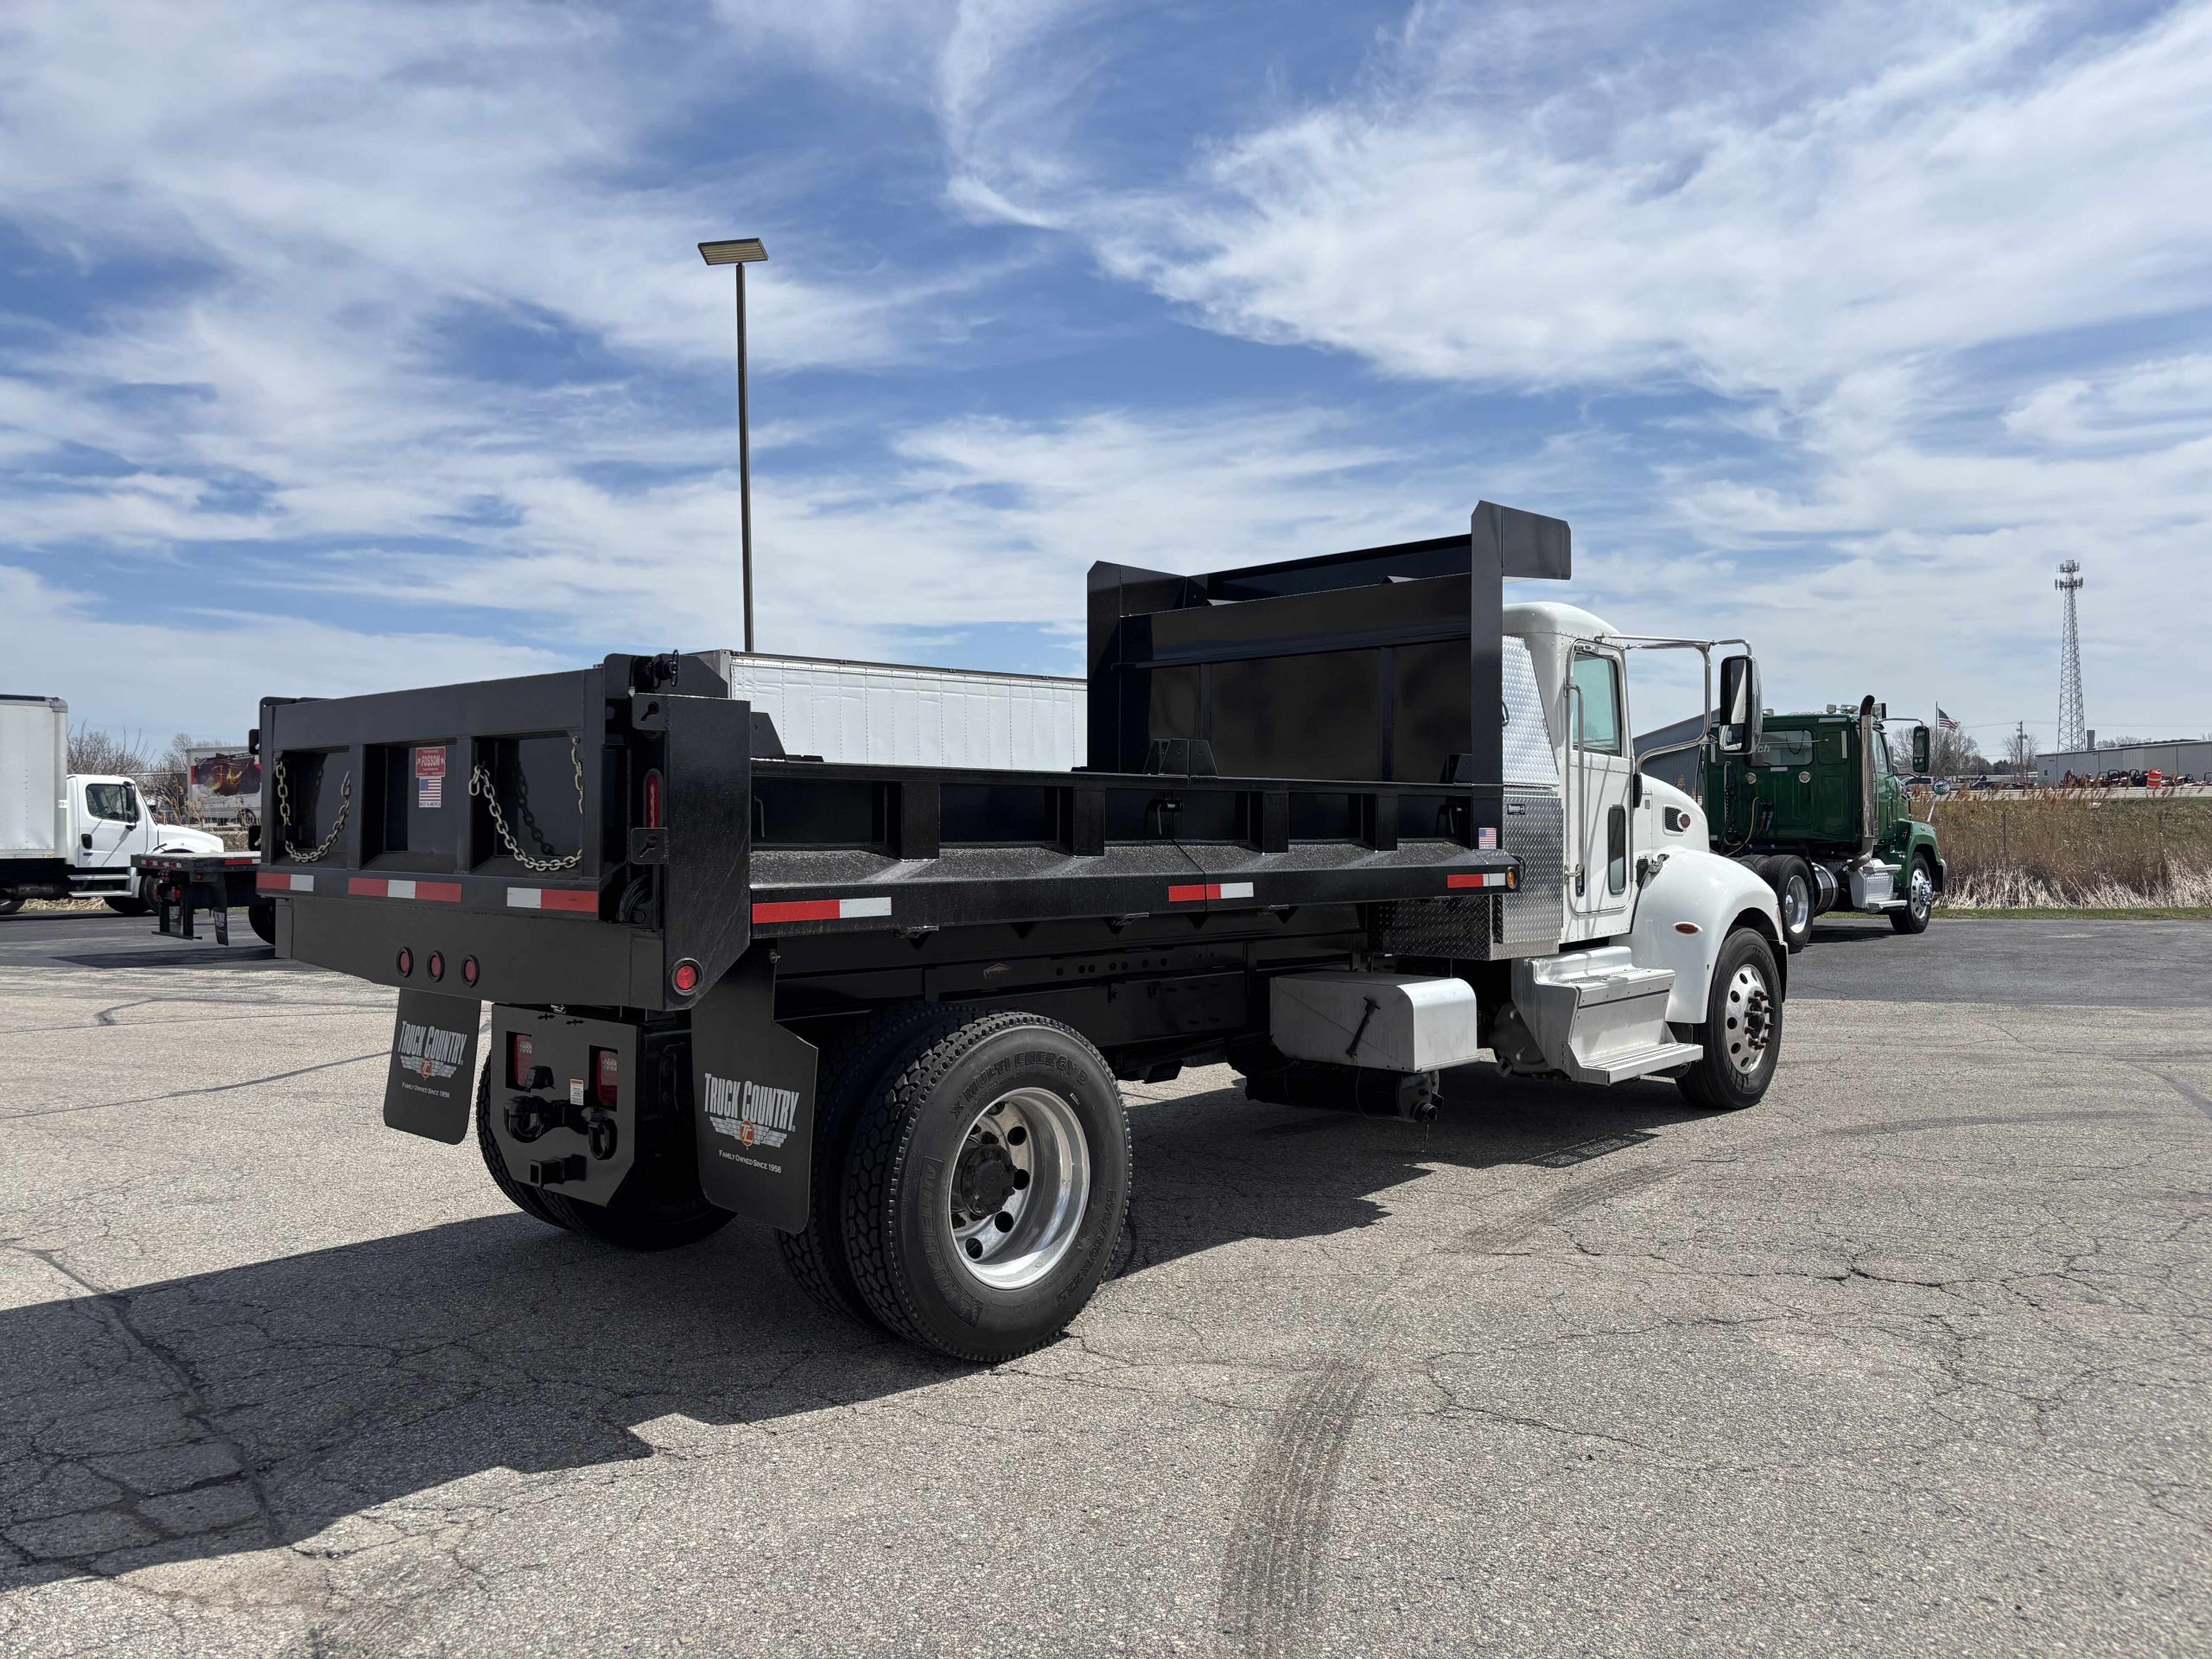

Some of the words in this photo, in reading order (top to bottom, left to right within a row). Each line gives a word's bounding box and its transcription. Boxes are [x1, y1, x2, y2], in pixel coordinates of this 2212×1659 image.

[397, 1020, 426, 1057] TRUCK
[424, 1026, 467, 1065] COUNTRY
[704, 1072, 741, 1118] TRUCK
[741, 1080, 799, 1131] COUNTRY
[963, 1057, 1010, 1102] MULTI
[1014, 1051, 1077, 1075] ENERGY
[753, 1159, 768, 1170] SINCE
[768, 1163, 782, 1173] 1958
[918, 1161, 961, 1301] MICHELIN
